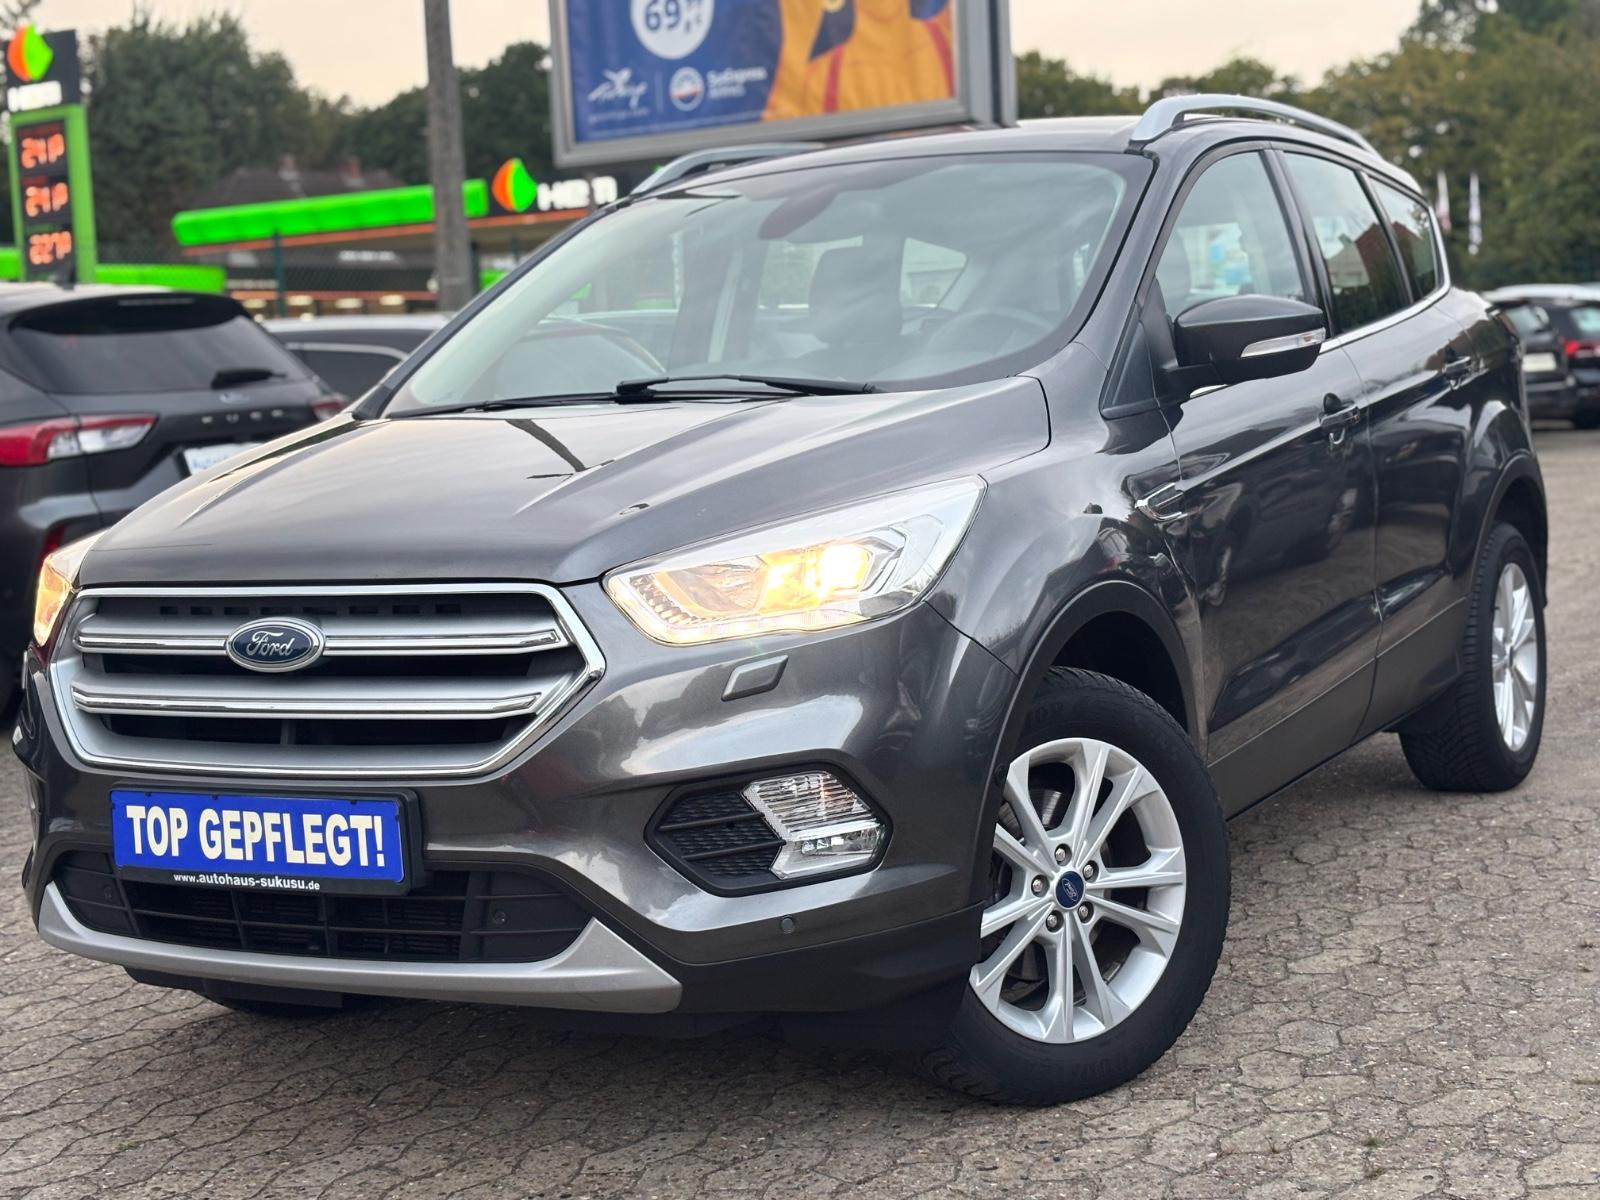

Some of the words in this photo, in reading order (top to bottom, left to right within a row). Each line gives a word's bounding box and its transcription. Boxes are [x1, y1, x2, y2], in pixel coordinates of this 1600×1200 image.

[246, 630, 296, 656] Ford
[126, 805, 189, 857] TOP
[198, 807, 385, 867] GEPFLEGT!
[173, 872, 321, 891] www.autohaus-sukusu.de
